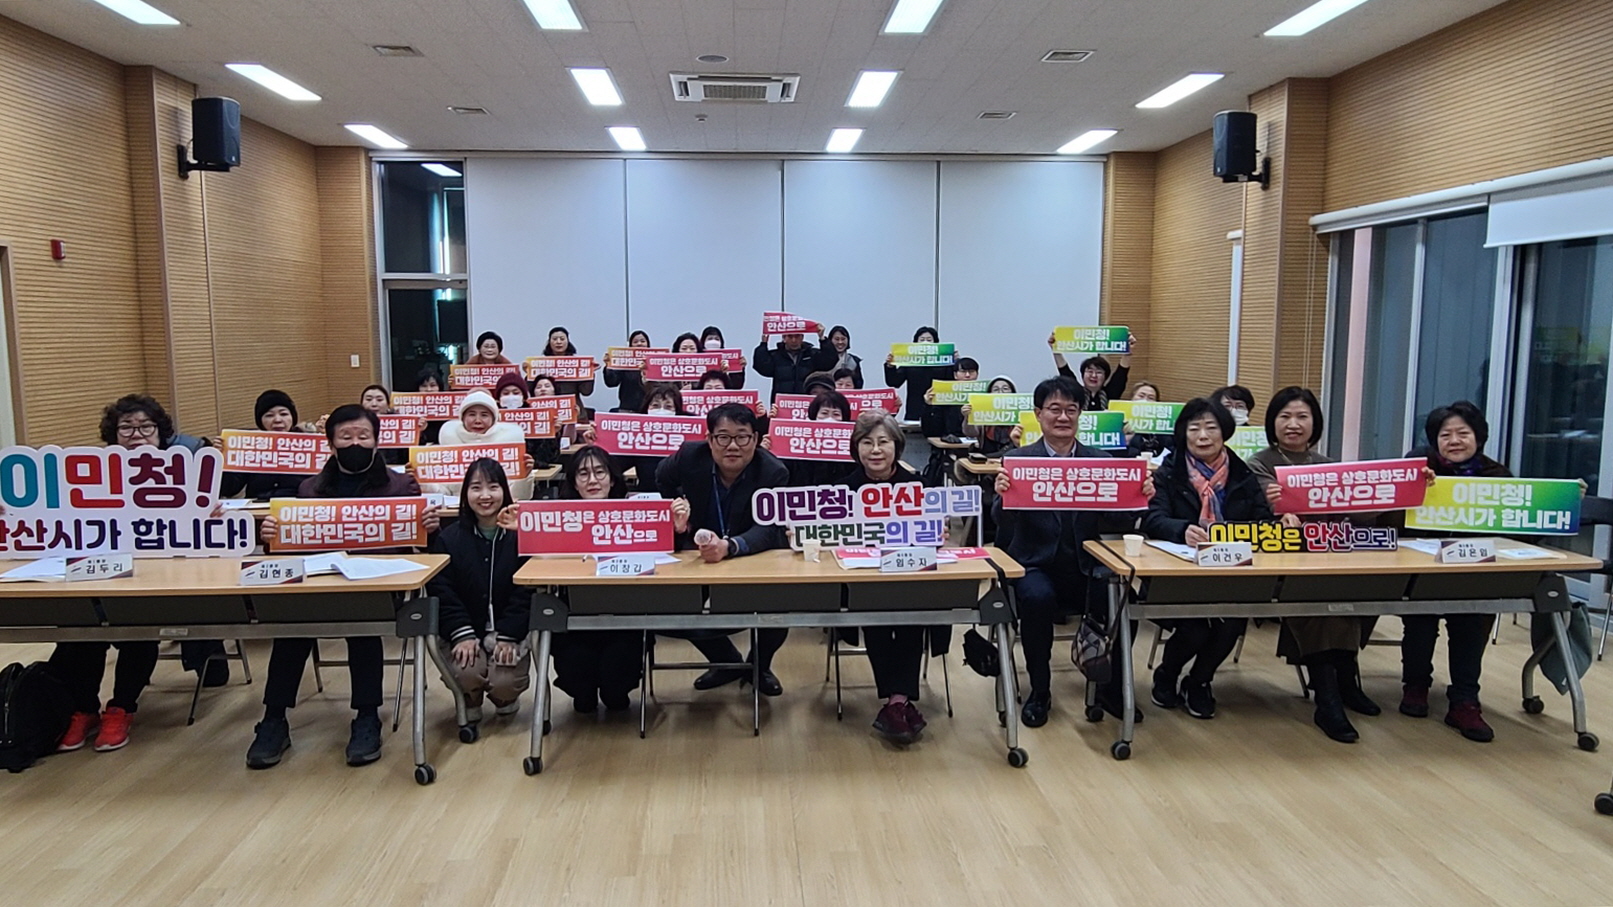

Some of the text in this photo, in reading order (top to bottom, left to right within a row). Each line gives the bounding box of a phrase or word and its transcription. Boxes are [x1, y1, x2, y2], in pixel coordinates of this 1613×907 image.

[767, 321, 806, 332] 안산으로
[1074, 328, 1110, 340] 이민청!
[908, 345, 938, 355] 이민청!
[1057, 340, 1126, 351] 안산시가 합니다!
[531, 359, 591, 367] 이민청! 안산의 길!
[650, 357, 677, 366] 이민청은
[678, 357, 718, 366] 상호문화도시
[895, 355, 953, 364] 안산시가 합니다!
[454, 367, 480, 376] 이민청!
[481, 367, 504, 375] 안산의
[579, 367, 591, 377] 길!
[661, 365, 707, 377] 안산으로
[952, 382, 986, 392] 이민청!
[393, 396, 423, 405] 이민청!
[425, 395, 452, 404] 안산의
[559, 399, 571, 408] 길!
[706, 395, 754, 404] 상호문화도시
[504, 411, 534, 421] 안산의
[536, 410, 550, 421] 길!
[558, 408, 572, 420] 길!
[974, 410, 1016, 422] 안산시가
[1132, 405, 1172, 419] 이민청!
[402, 418, 416, 429] 길!
[534, 421, 550, 434] 길!
[601, 419, 702, 435] 이민청은 상호문화도시
[399, 430, 416, 443] 길!
[774, 426, 813, 438] 이민청은
[227, 435, 273, 451] 이민청!
[277, 438, 316, 452] 안산의
[617, 432, 685, 450] 안산으로
[789, 437, 851, 456] 안산으로
[227, 450, 311, 468] 대한민국의
[416, 450, 458, 464] 이민청!
[502, 447, 519, 461] 길!
[0, 453, 216, 509] 이민청!
[1012, 466, 1141, 482] 이민청은 상호문화도시
[1287, 467, 1418, 488] 이민청은 상호문화도시
[1032, 481, 1119, 502] 안산으로
[1308, 484, 1396, 508] 안산으로
[1452, 482, 1533, 507] 이민청!
[756, 487, 855, 522] 이민청!
[861, 481, 947, 519] 안산의
[279, 503, 417, 523] 이민청! 안산의 길!
[1415, 505, 1571, 530] 안산시가 합니다!
[520, 509, 671, 533] 이민청은 상호문화도시
[131, 518, 248, 551] 합니다!
[280, 521, 417, 545] 대한민국의 길!
[591, 523, 658, 545] 안산으로
[794, 519, 943, 547] 대한민국의 길!
[1211, 523, 1397, 552] 이민청은 안산으로!
